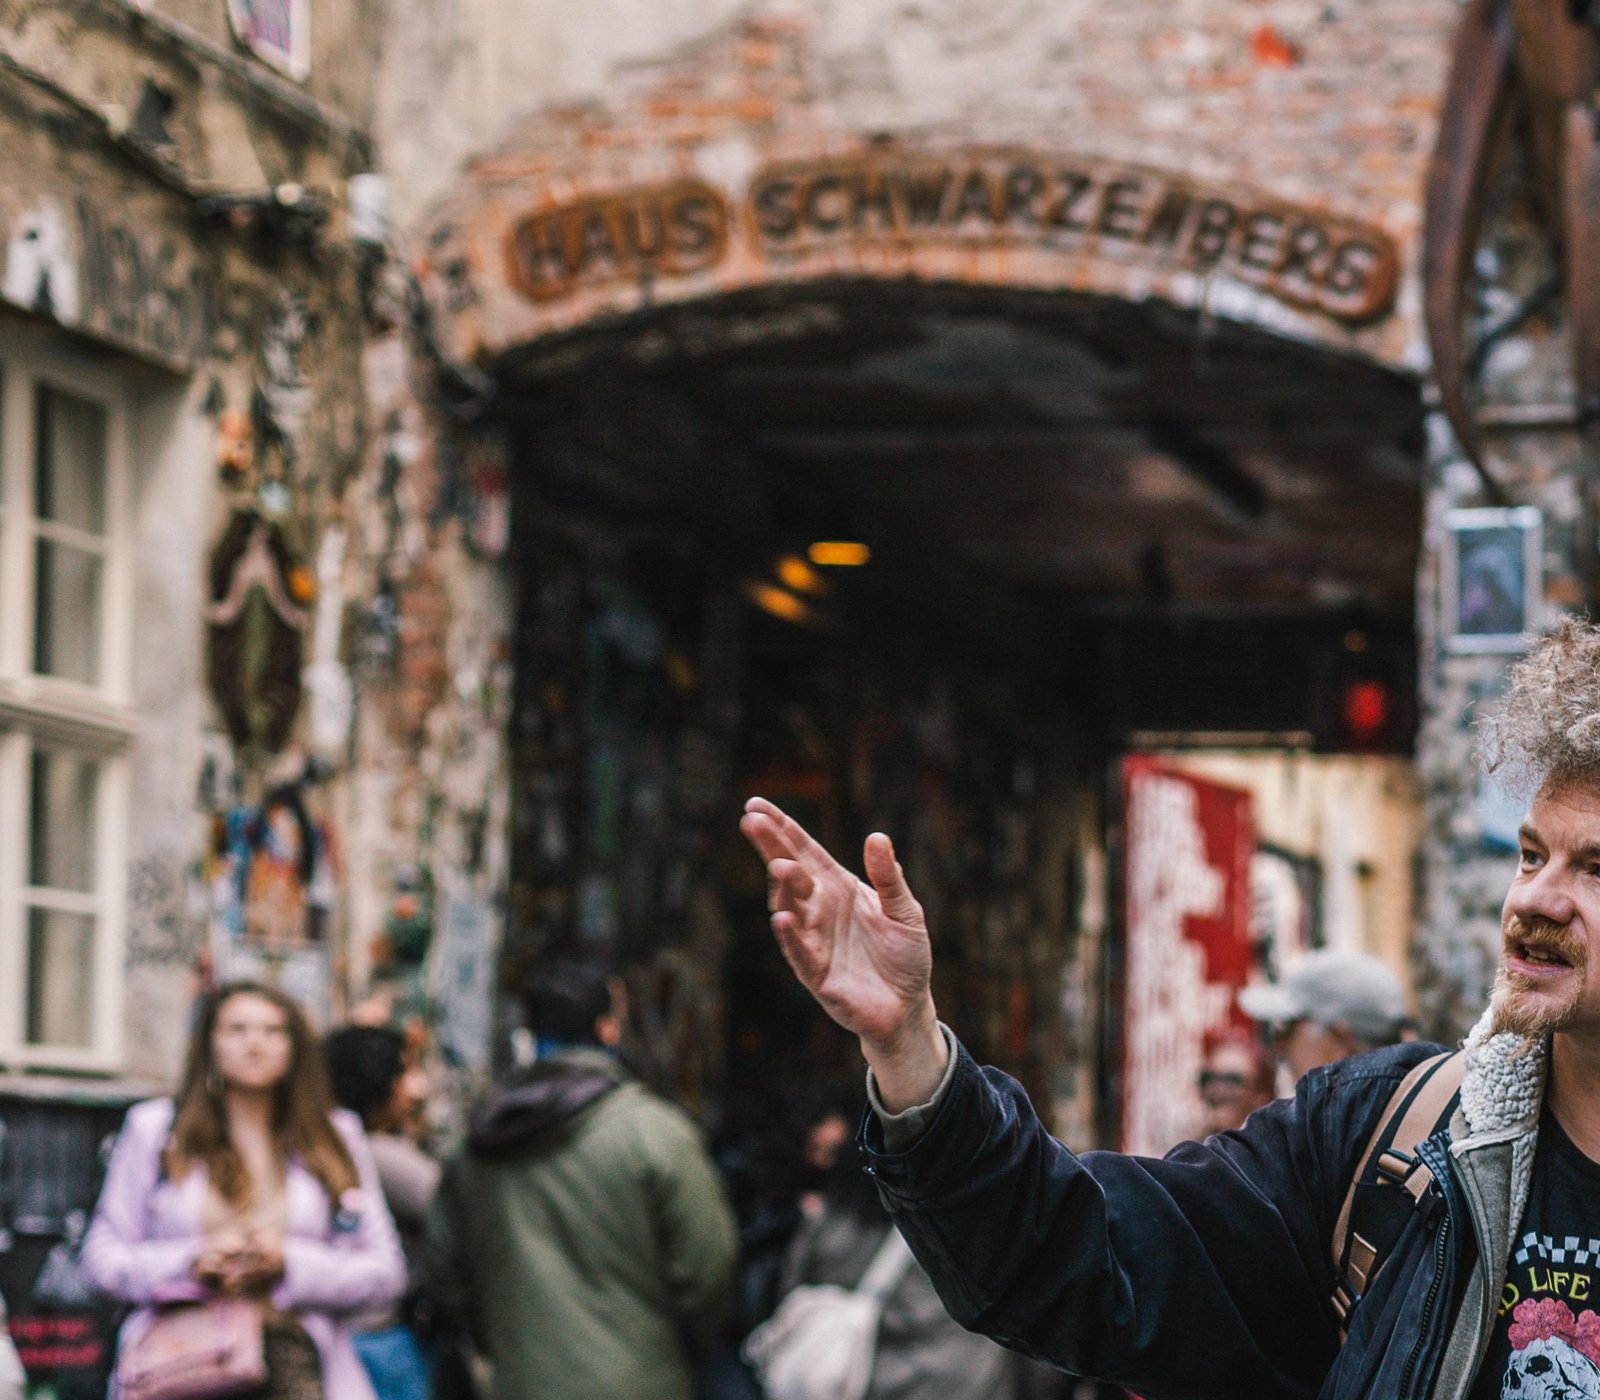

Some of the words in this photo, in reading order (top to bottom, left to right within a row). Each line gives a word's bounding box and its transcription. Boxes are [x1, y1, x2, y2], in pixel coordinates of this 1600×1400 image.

[517, 199, 714, 286] HAUS
[756, 167, 1384, 299] SCHWARZENBERG
[1498, 1283, 1520, 1316] D
[1528, 1266, 1590, 1300] LIFE
